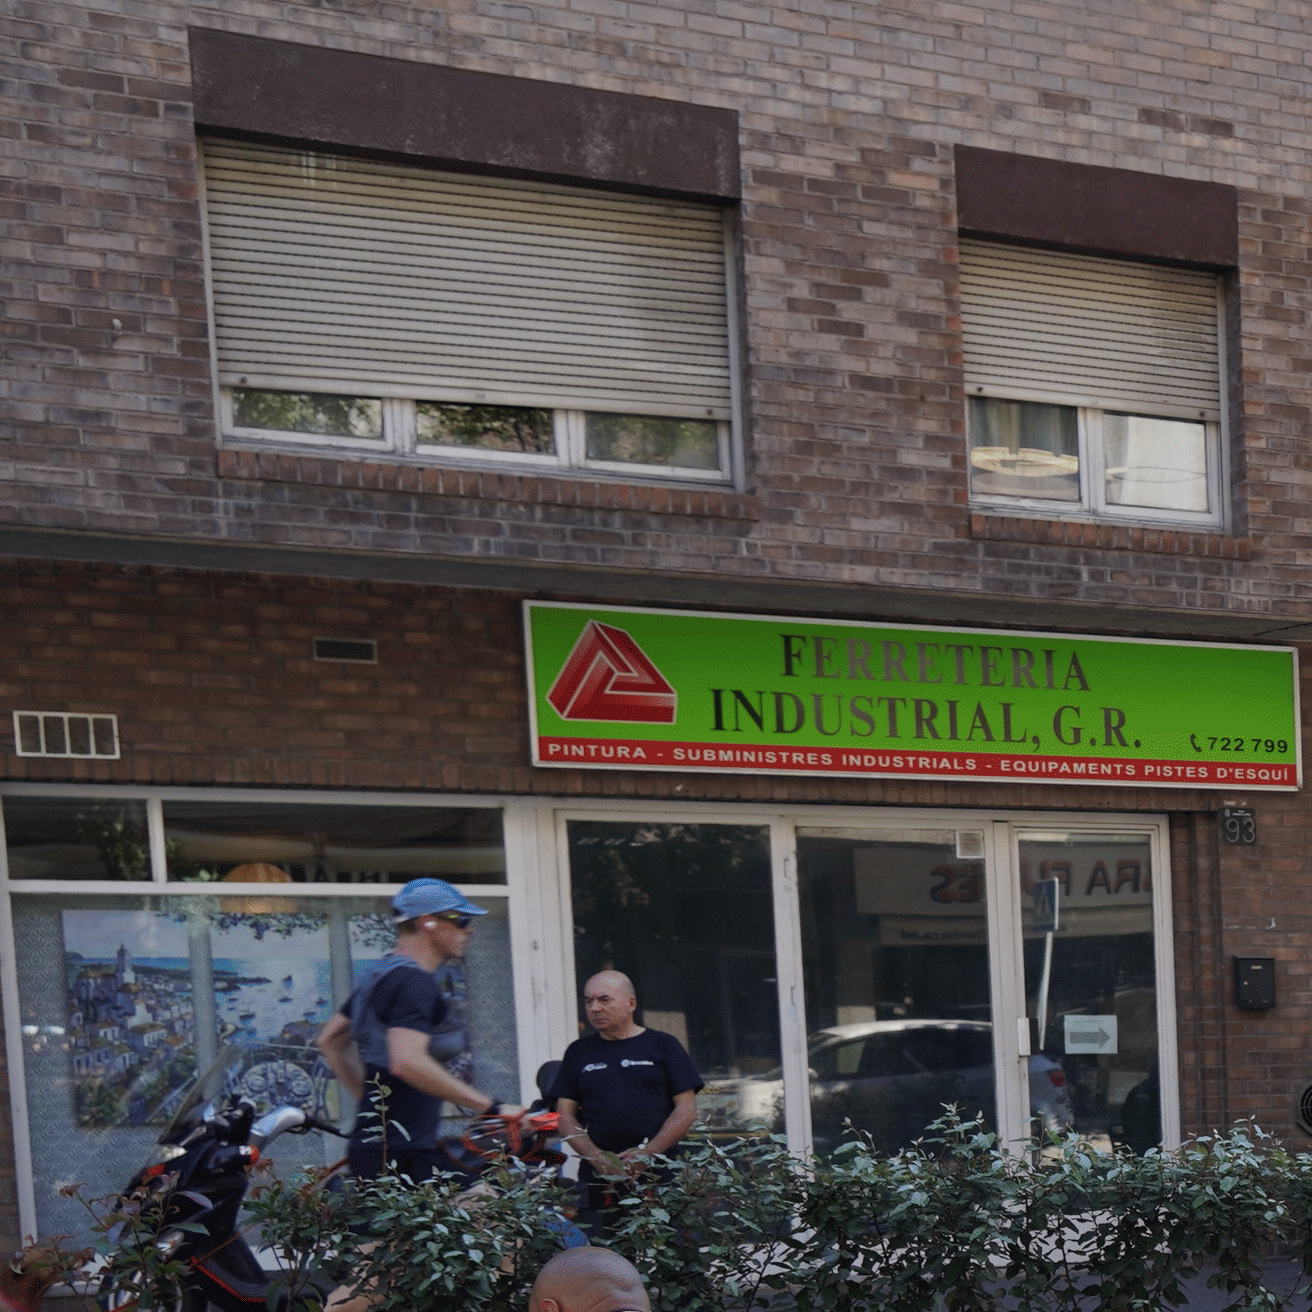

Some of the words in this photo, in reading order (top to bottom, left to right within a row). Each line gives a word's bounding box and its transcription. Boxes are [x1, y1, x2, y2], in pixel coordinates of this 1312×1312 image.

[779, 633, 1092, 693] FERRETERIA
[709, 687, 1042, 751] INDUSTRIAL,
[1052, 705, 1142, 750] G.R.
[548, 742, 647, 761] PINTURA
[672, 746, 834, 768] SUBMINISTRES
[839, 753, 978, 773] INDUSTRIALS
[999, 758, 1138, 778] EQUIPAMENTS
[1142, 763, 1212, 781] PISTES
[1215, 763, 1290, 784] D'ESQUÍ
[1206, 735, 1246, 754] 722
[1250, 737, 1289, 755] 799
[1225, 816, 1257, 844] 93
